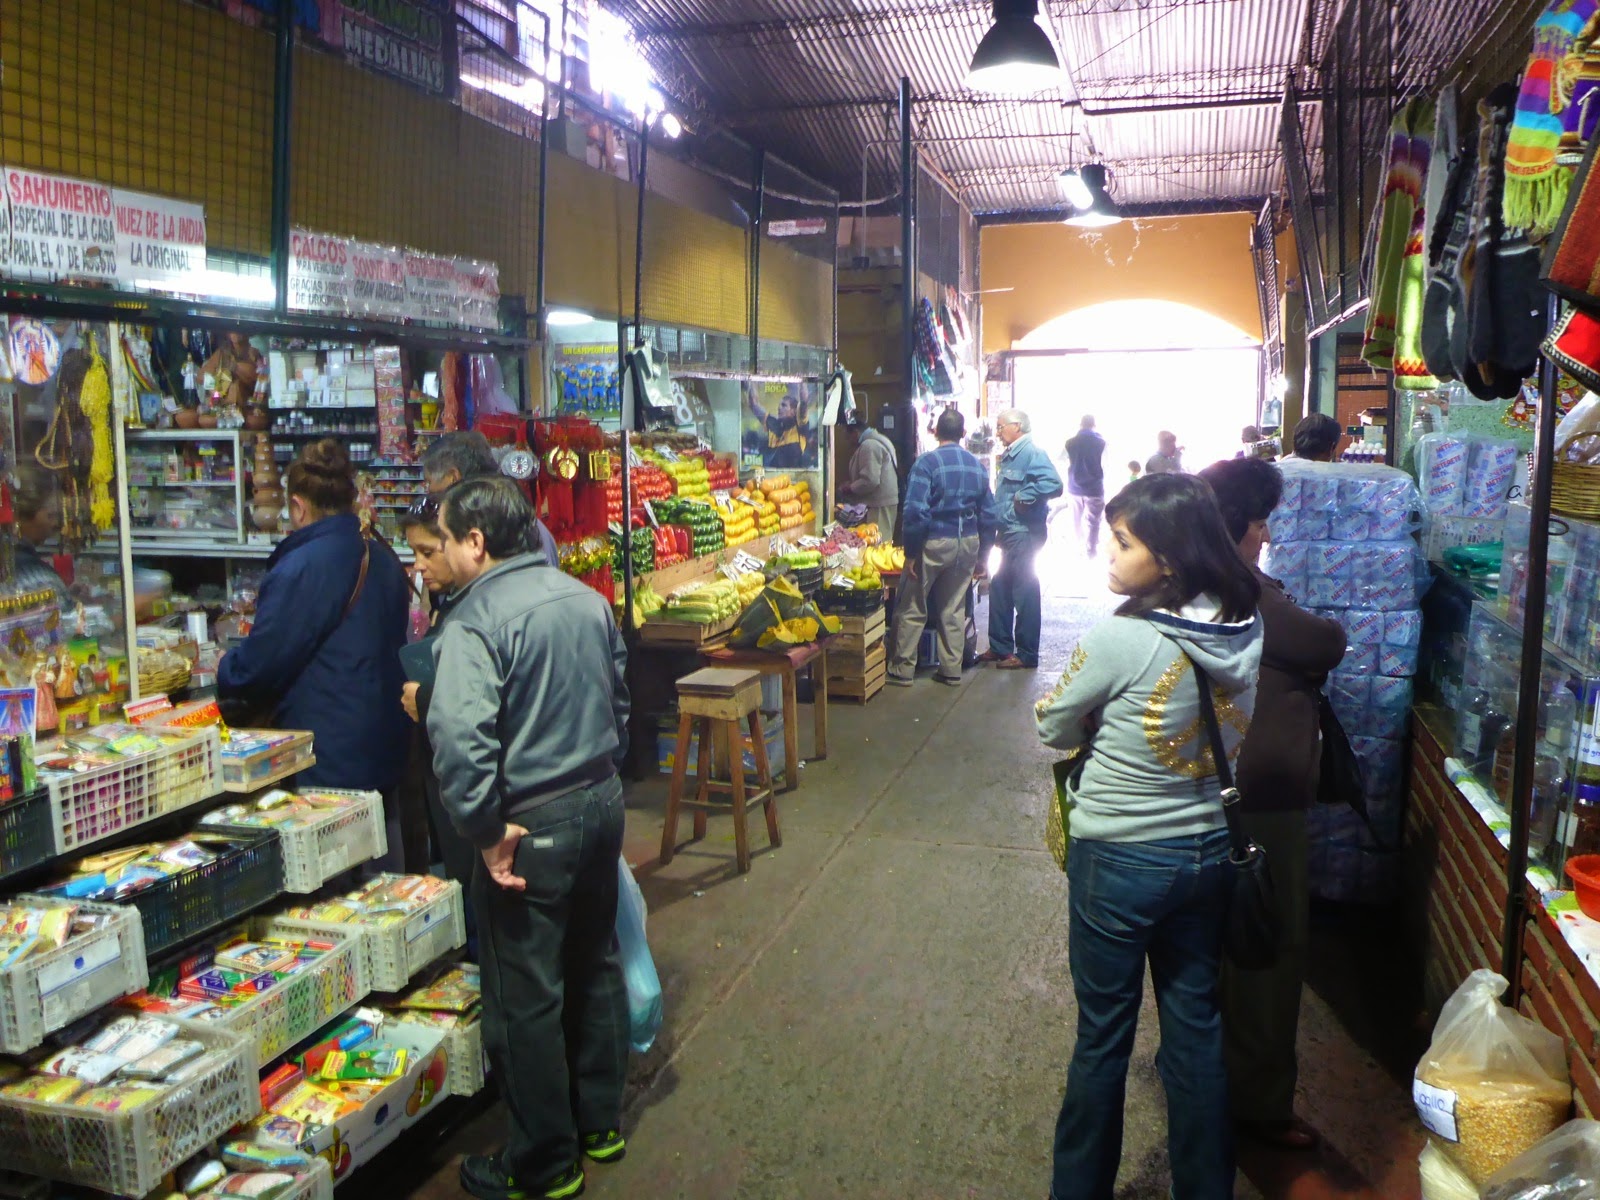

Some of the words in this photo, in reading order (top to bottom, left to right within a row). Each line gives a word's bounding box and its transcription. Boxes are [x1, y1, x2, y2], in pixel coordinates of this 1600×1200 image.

[343, 20, 444, 93] MEDALLAS
[9, 172, 112, 218] SAHUMERIO
[13, 204, 59, 237] ESPECIAL
[61, 212, 74, 240] DE
[76, 215, 89, 242] LA
[90, 217, 116, 245] CASA
[116, 204, 143, 238] NUEZ
[146, 209, 159, 240] DE
[162, 213, 175, 242] LA
[177, 216, 205, 246] INDIA
[13, 238, 39, 267] PARA
[40, 241, 54, 269] EL
[67, 244, 80, 271] DE
[130, 240, 144, 267] LA
[146, 243, 192, 272] ORIGINAL
[292, 234, 348, 265] CALCOS
[290, 276, 322, 295] GRACIAS
